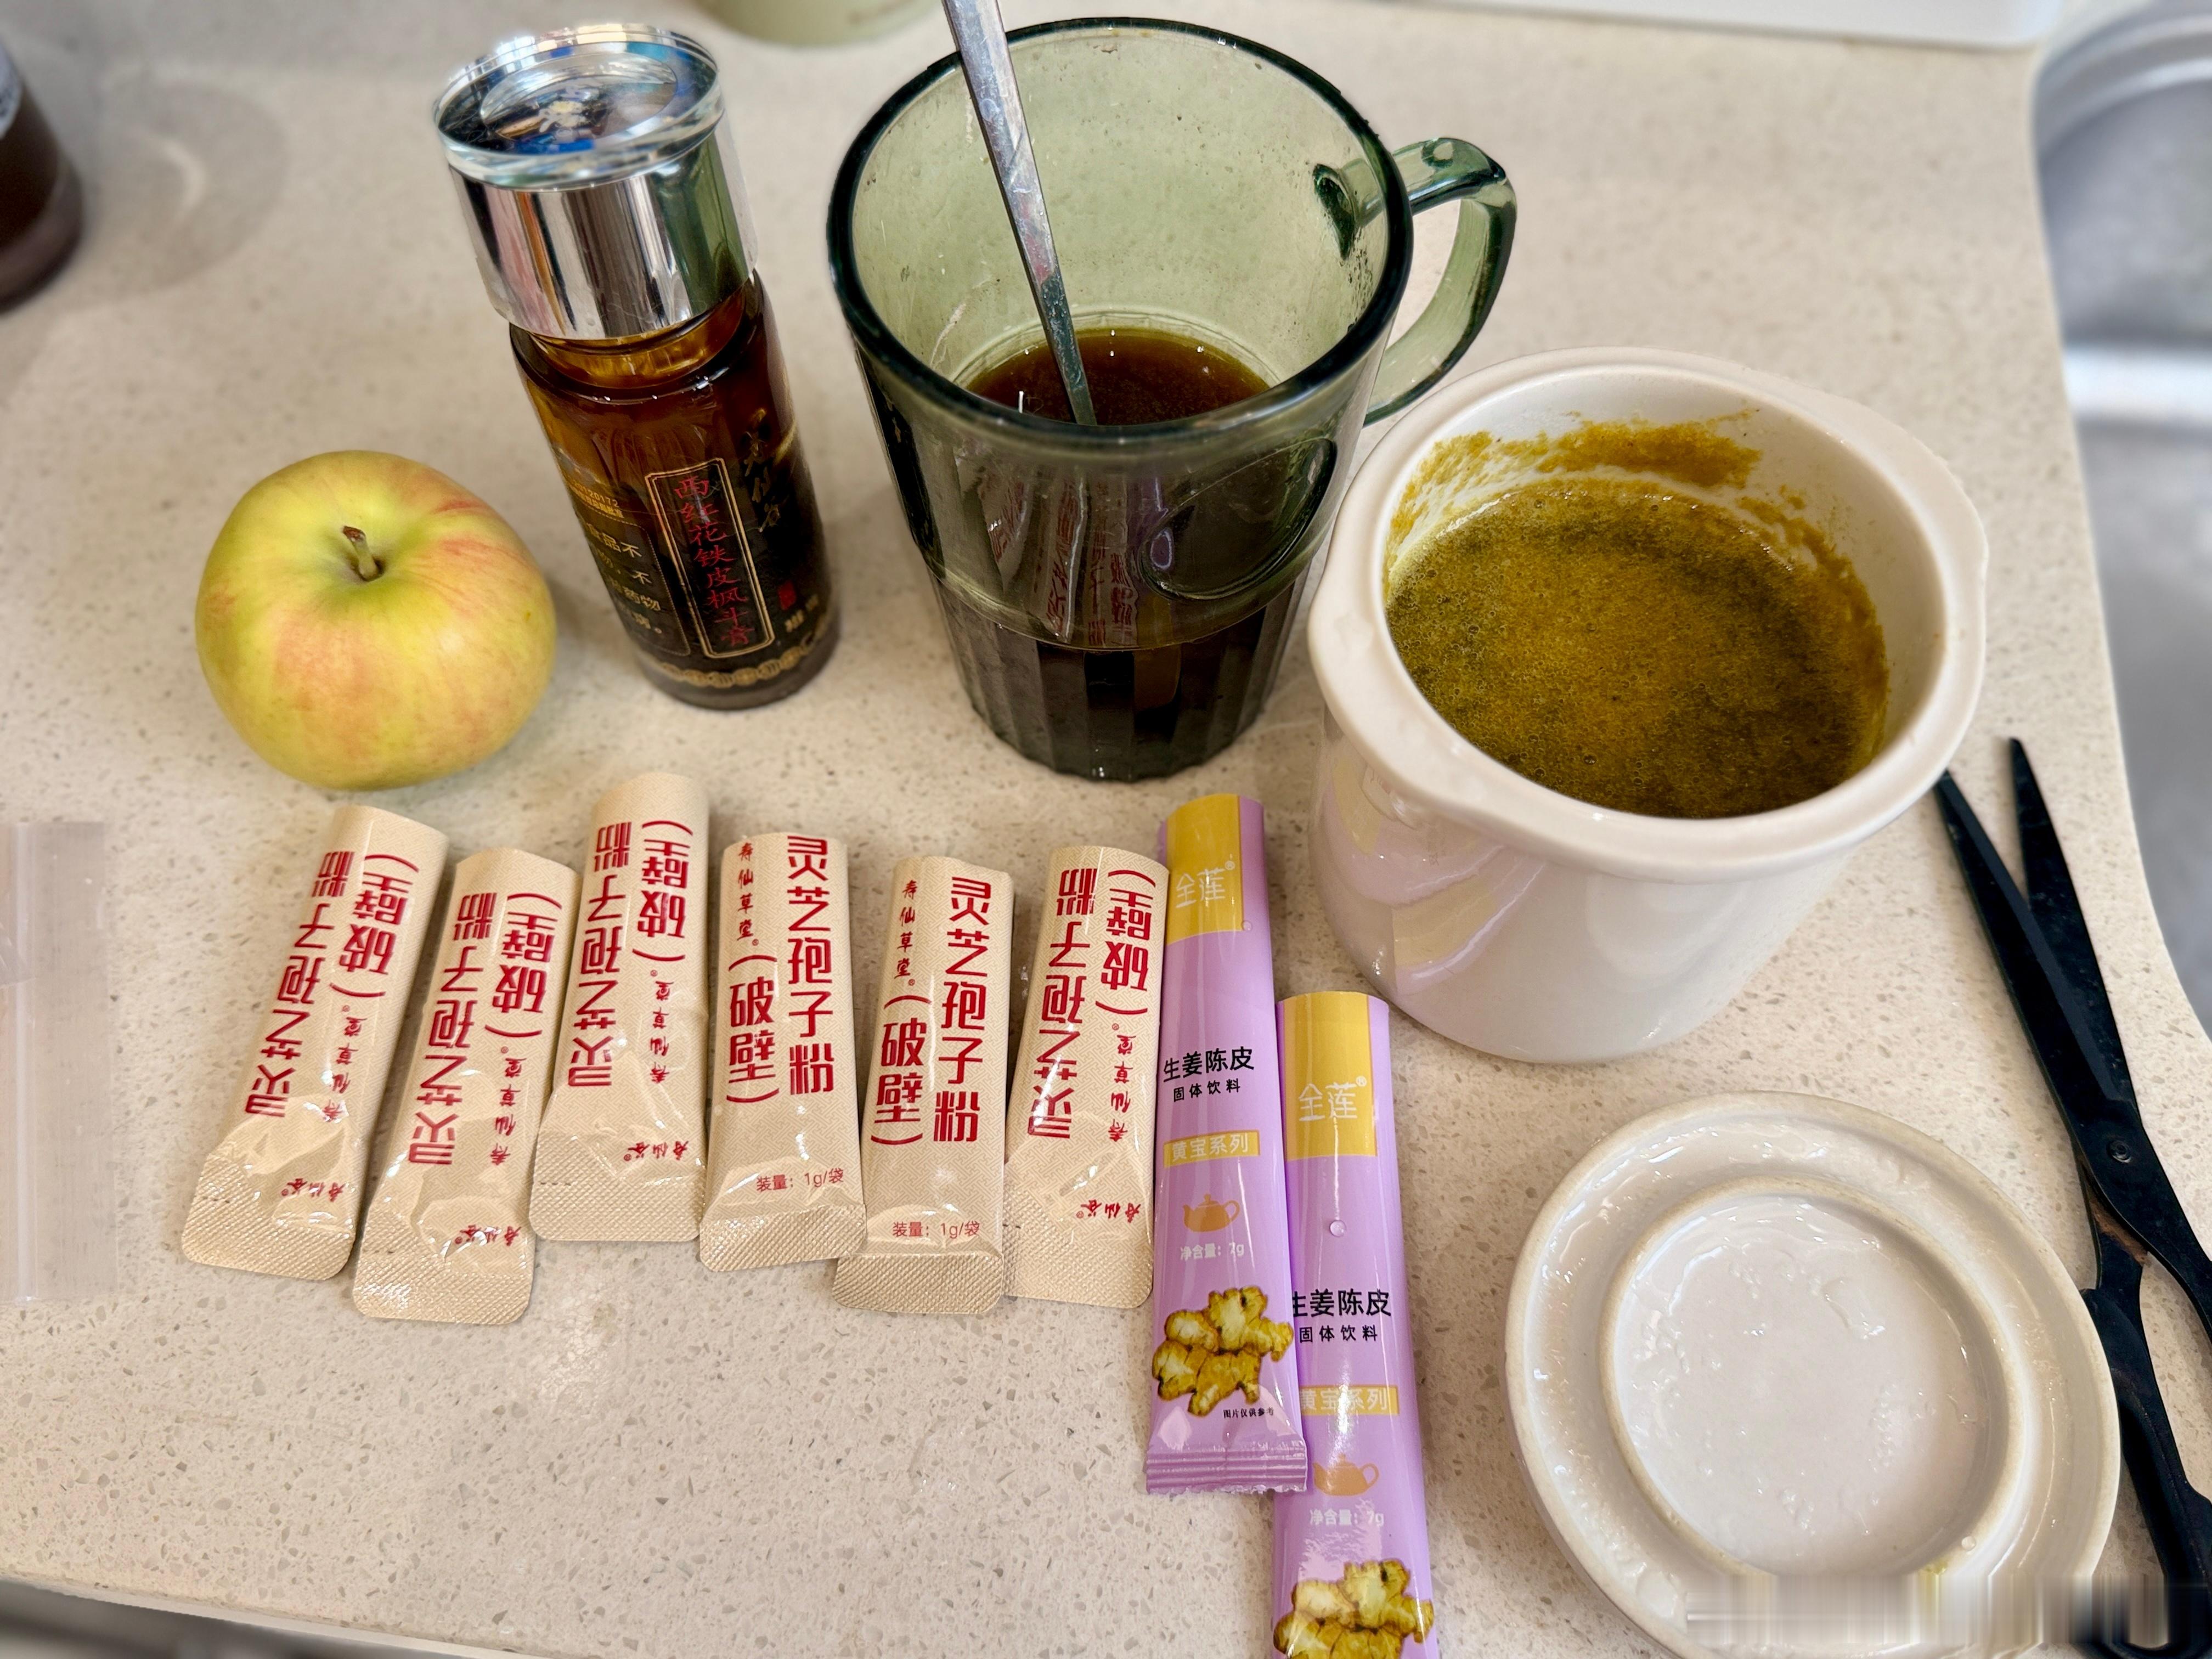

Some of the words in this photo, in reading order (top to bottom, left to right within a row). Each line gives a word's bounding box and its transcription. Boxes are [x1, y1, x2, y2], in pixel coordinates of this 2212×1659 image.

[244, 850, 355, 1117] 灵芝孢子粉
[568, 821, 632, 1087] 灵芝孢子粉
[787, 836, 834, 1094] 灵芝孢子粉
[933, 876, 991, 1142] 灵芝孢子粉
[1028, 868, 1097, 1139] 灵芝孢子粉
[408, 892, 497, 1165] 灵芝孢子粉
[1163, 1046, 1254, 1082] 生姜陈皮
[1173, 1078, 1240, 1102] 固体饮料
[1172, 1132, 1249, 1163] 黄宝系列
[1293, 1288, 1391, 1317] 生姜陈皮
[1299, 1325, 1378, 1343] 固体饮料
[1223, 1406, 1274, 1419] 图片仅供参考
